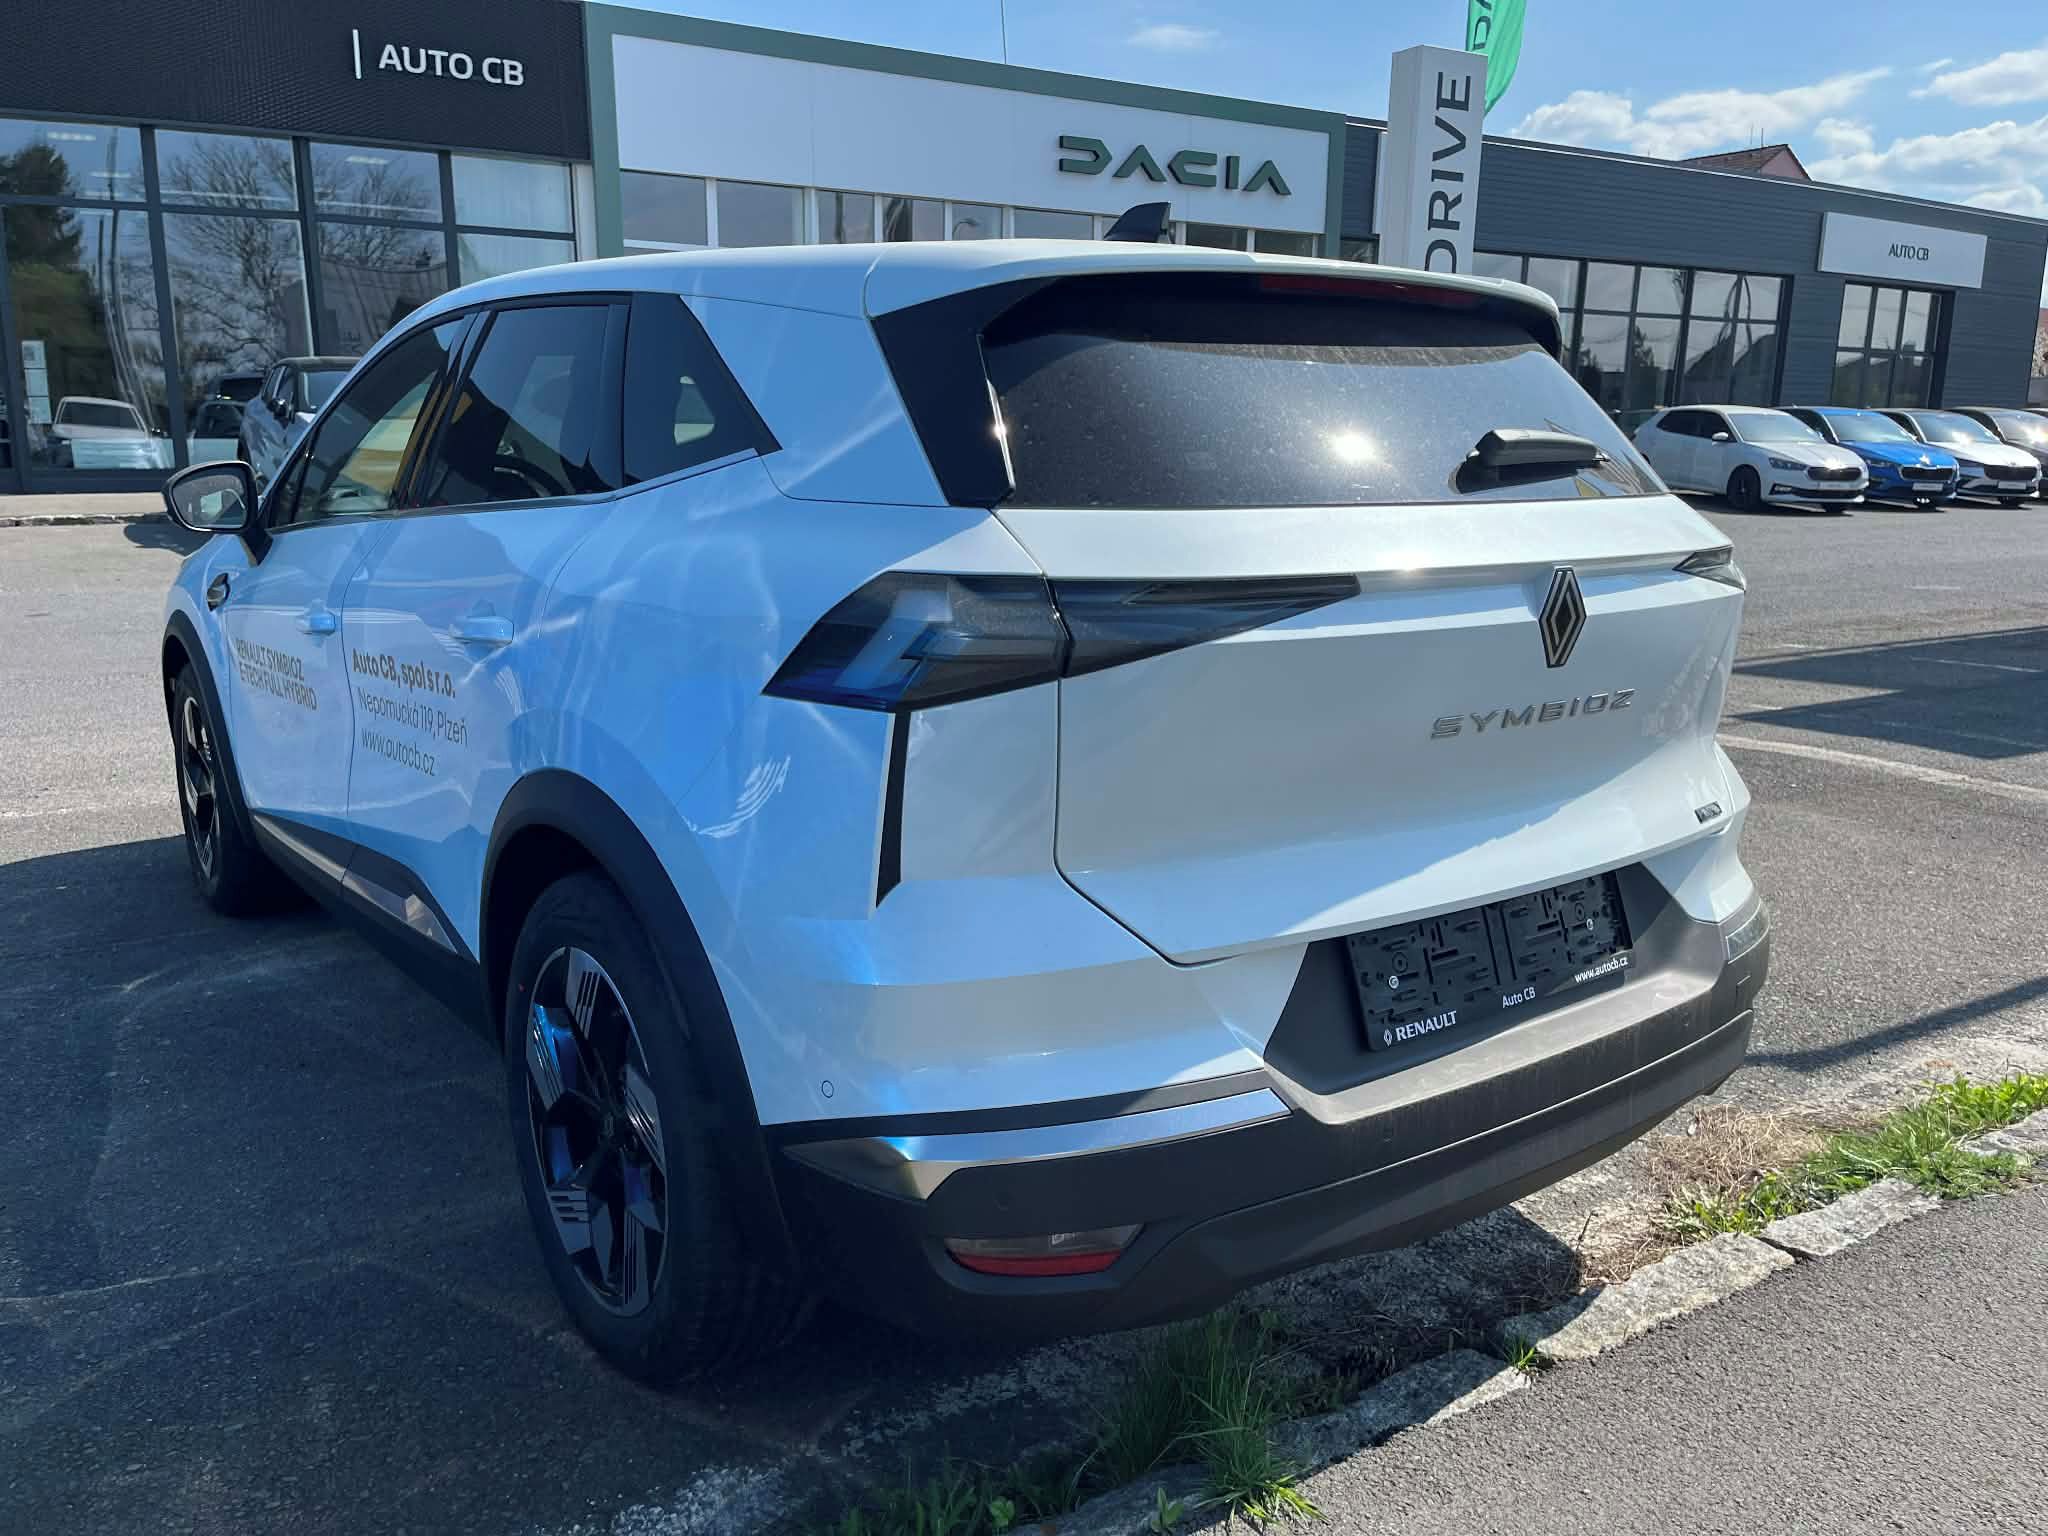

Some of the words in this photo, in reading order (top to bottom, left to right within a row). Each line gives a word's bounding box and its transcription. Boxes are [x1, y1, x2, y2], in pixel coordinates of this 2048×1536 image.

[378, 44, 473, 80] AUTO
[481, 57, 525, 86] CB
[1058, 135, 1292, 196] DACIA
[1424, 72, 1471, 274] DRIVE
[1888, 243, 1916, 260] AUTO
[1916, 247, 1930, 261] CB
[358, 687, 419, 728] Nepomucká
[419, 704, 436, 740] 119,
[437, 709, 468, 747] Plzeň
[1430, 688, 1637, 740] SYMBIOZ
[361, 727, 436, 777] www.autocb.cz
[1396, 1010, 1458, 1041] RENAULT
[1502, 992, 1524, 1009] Auto
[1523, 986, 1537, 1000] CB
[1574, 956, 1629, 983] www.autocb.cz
